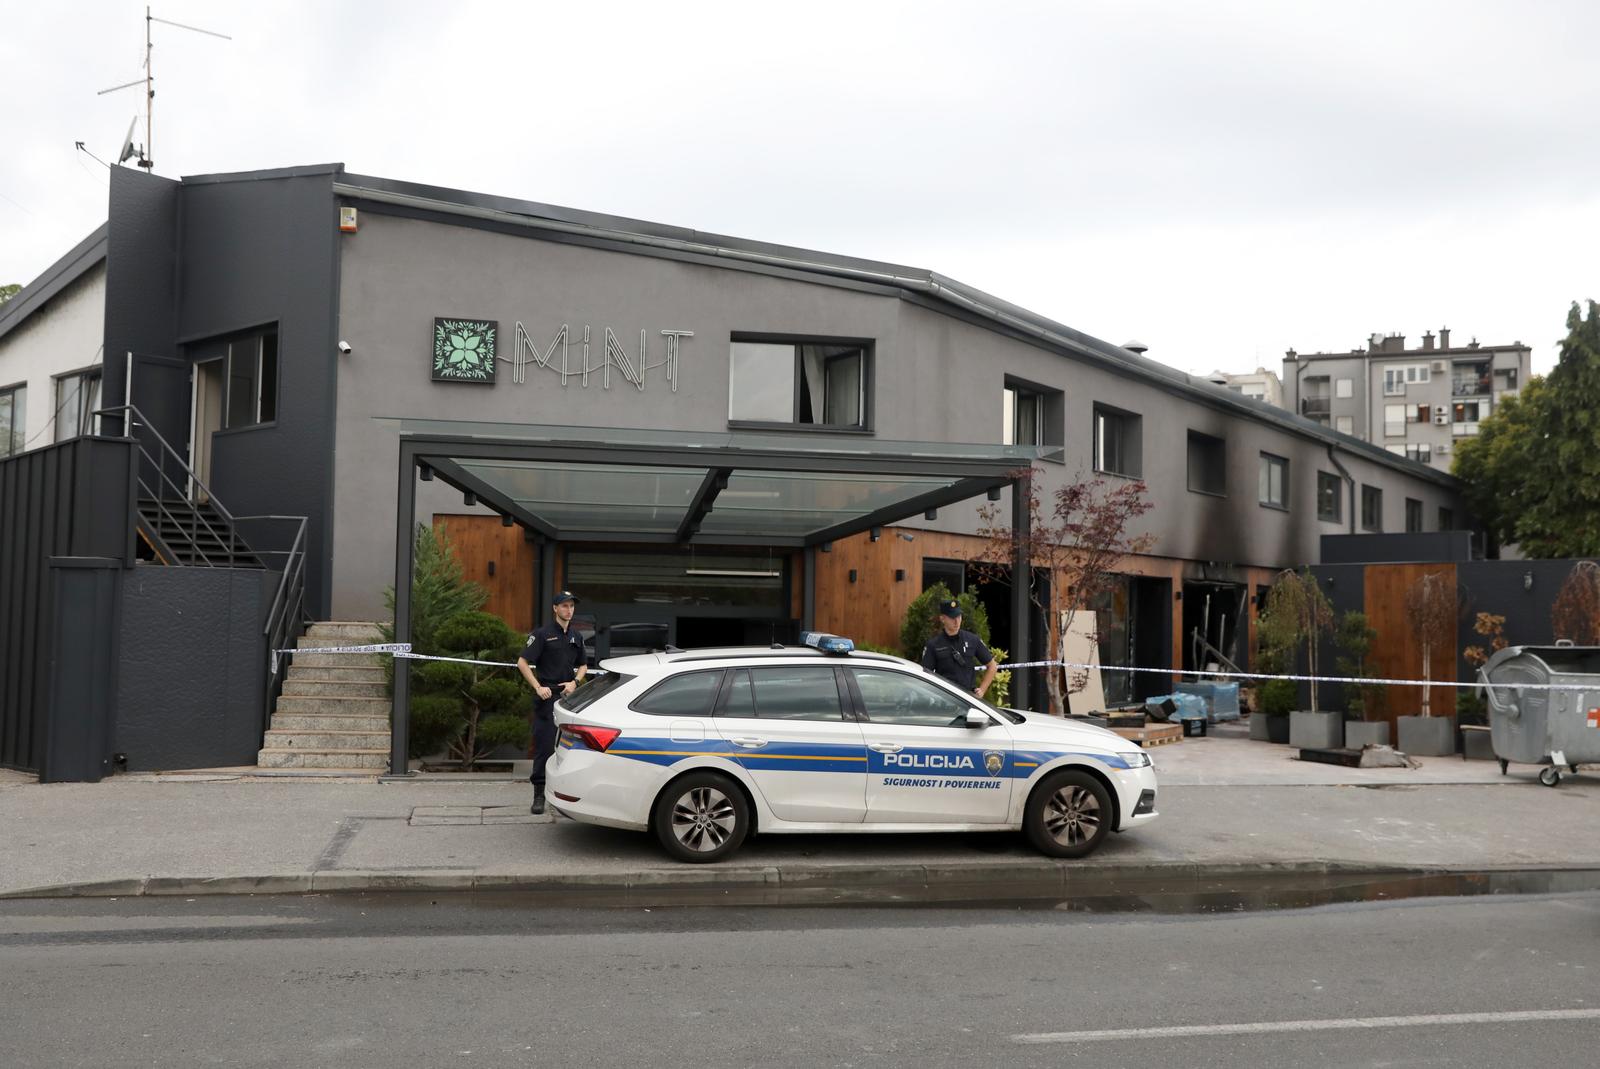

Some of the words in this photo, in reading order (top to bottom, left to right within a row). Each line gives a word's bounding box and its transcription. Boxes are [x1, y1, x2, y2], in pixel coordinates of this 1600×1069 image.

[385, 644, 411, 652] OLICIJA
[883, 753, 974, 769] POLICIJA
[883, 777, 937, 788] SIGURNOST
[938, 779, 943, 788] I
[944, 780, 1001, 789] POVJERENJE
